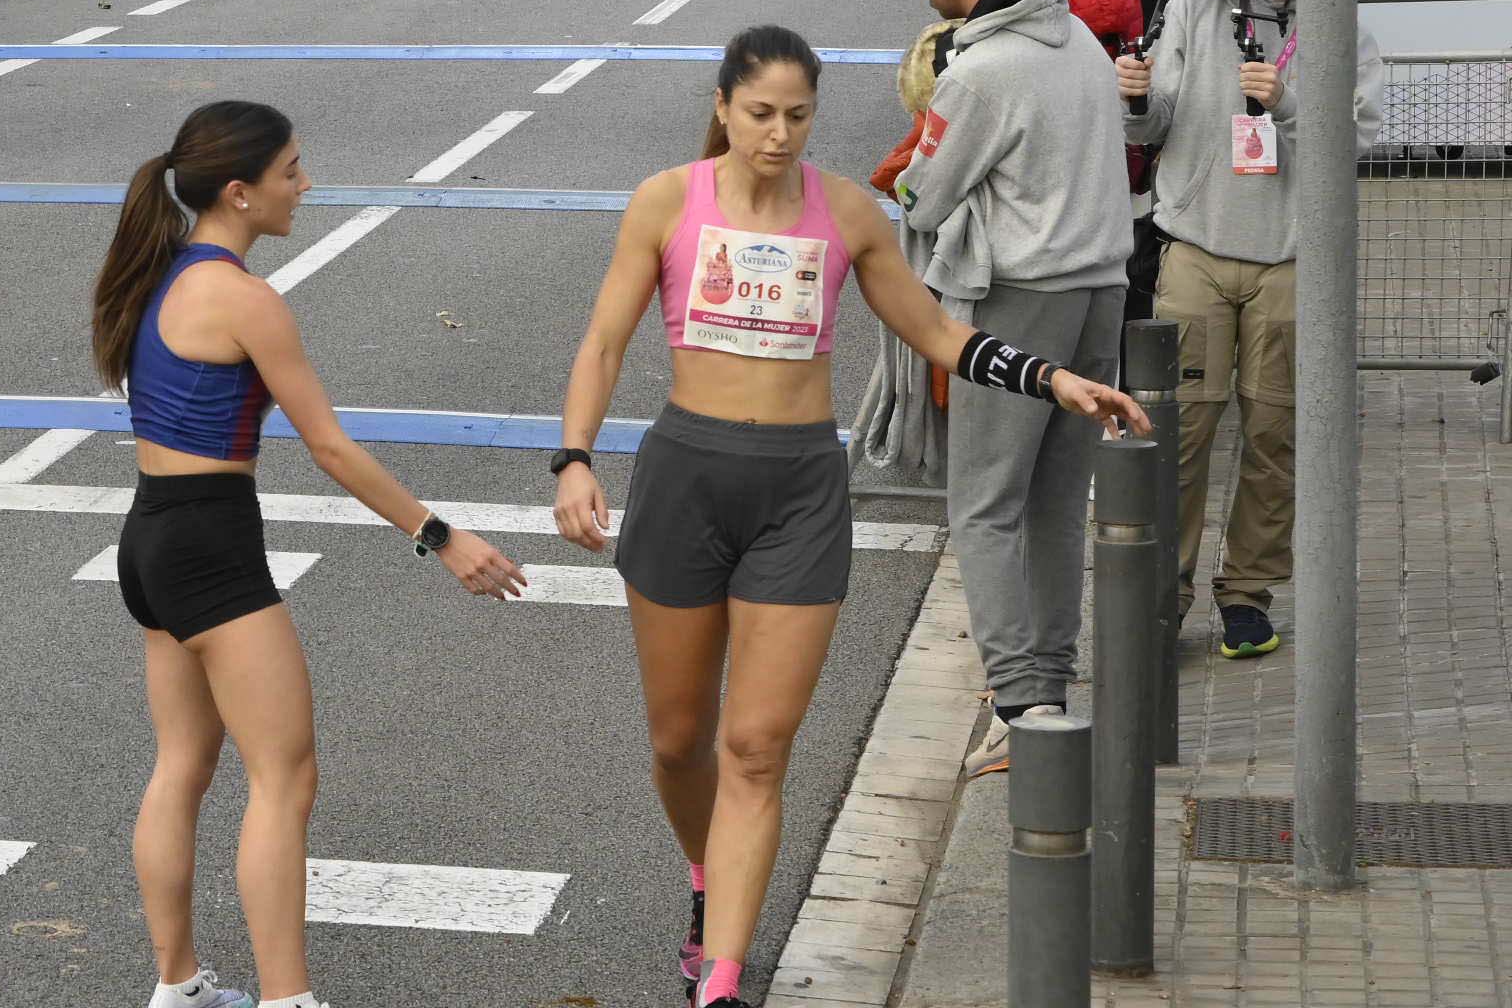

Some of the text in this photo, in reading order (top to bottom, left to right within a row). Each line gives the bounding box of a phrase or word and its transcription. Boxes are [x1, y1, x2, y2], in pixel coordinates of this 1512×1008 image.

[738, 281, 782, 300] 016
[750, 305, 763, 315] 23
[702, 315, 739, 326] CARRERA
[740, 320, 752, 328] DE
[753, 321, 763, 329] LA
[696, 328, 739, 344] OYSHO
